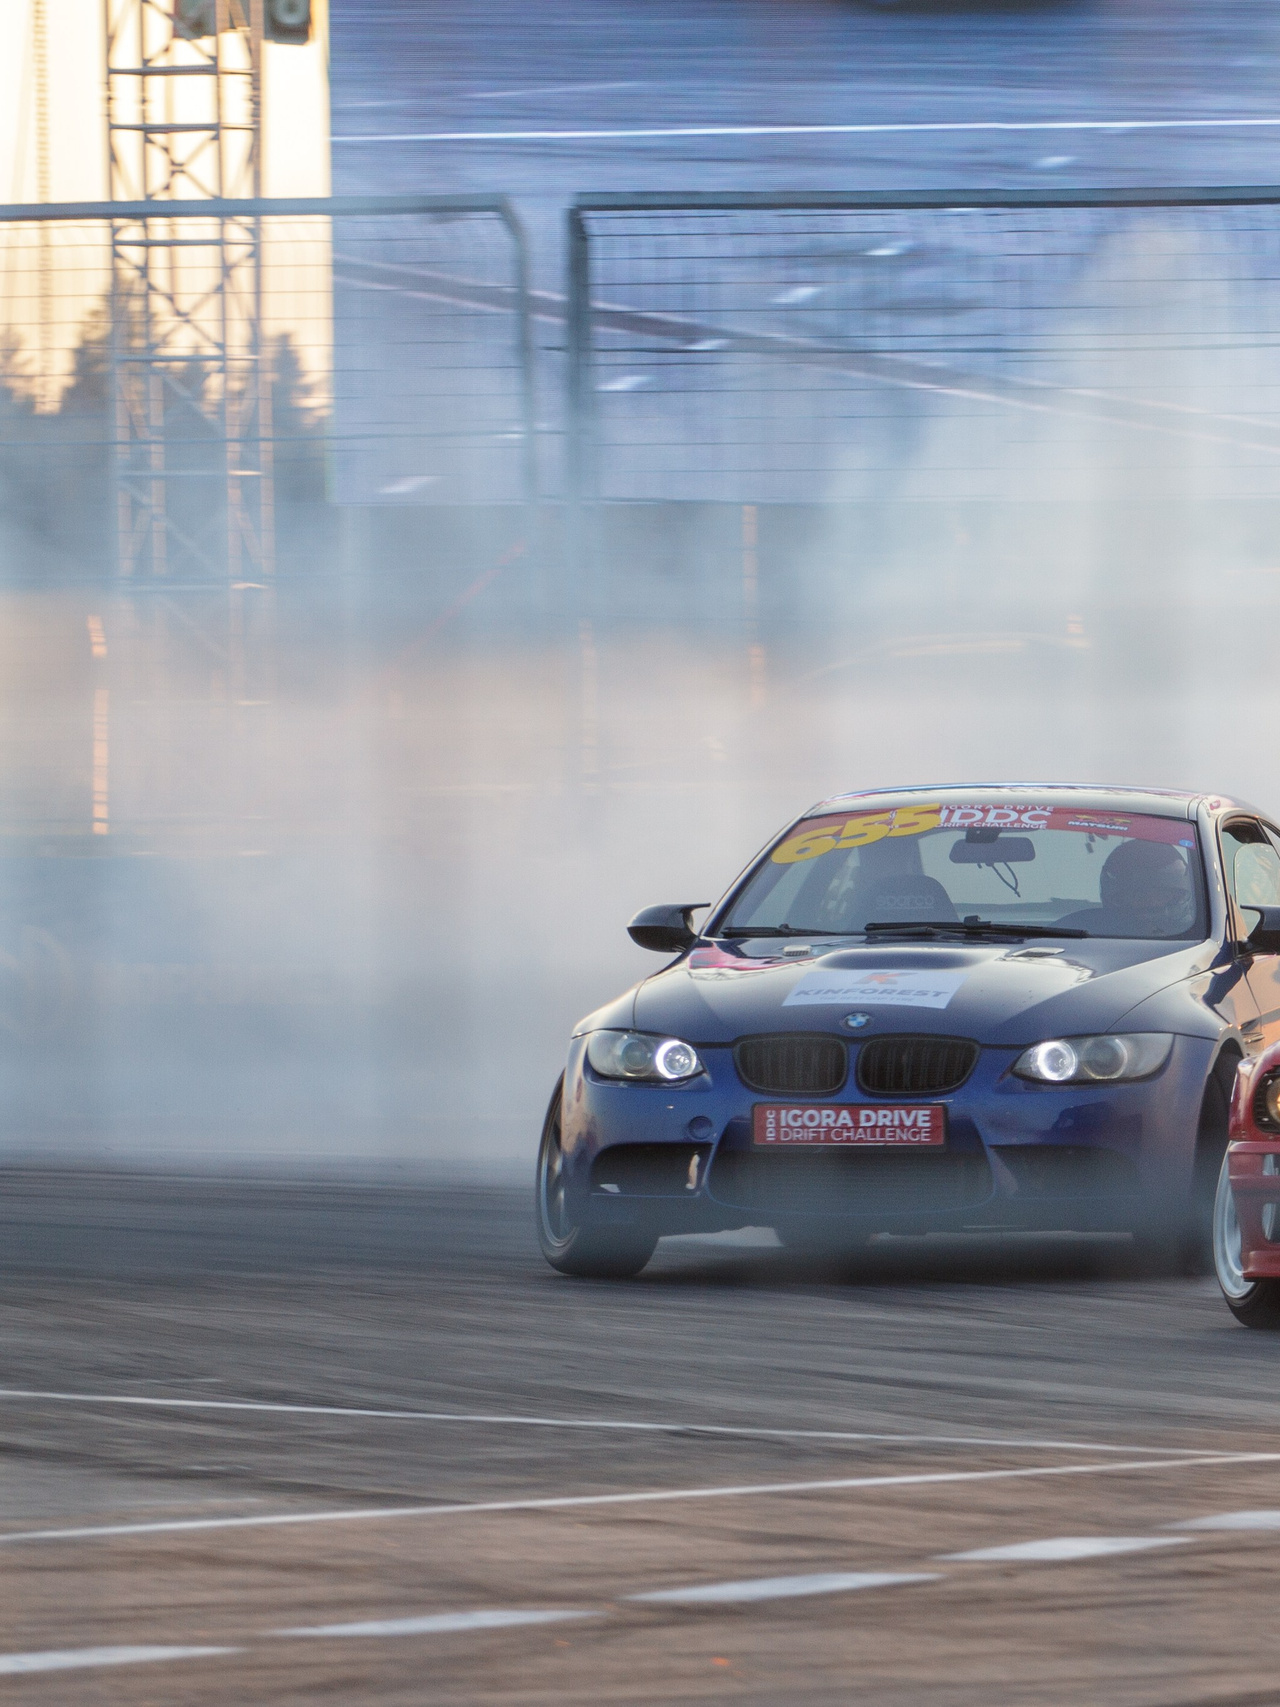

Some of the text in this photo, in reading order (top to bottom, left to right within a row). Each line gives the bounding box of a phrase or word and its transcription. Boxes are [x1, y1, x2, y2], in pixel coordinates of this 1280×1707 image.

[1003, 804, 1054, 812] DRIVE
[940, 808, 1052, 824] IDDC
[972, 821, 1047, 830] CHALLENGE
[1067, 820, 1129, 831] MATSURI
[771, 802, 942, 864] 655
[794, 988, 950, 998] KINFOREST
[780, 1109, 932, 1127] IGORA DRIVE
[766, 1110, 776, 1141] IDDC
[780, 1128, 932, 1142] DRIFT CHALLENGE
